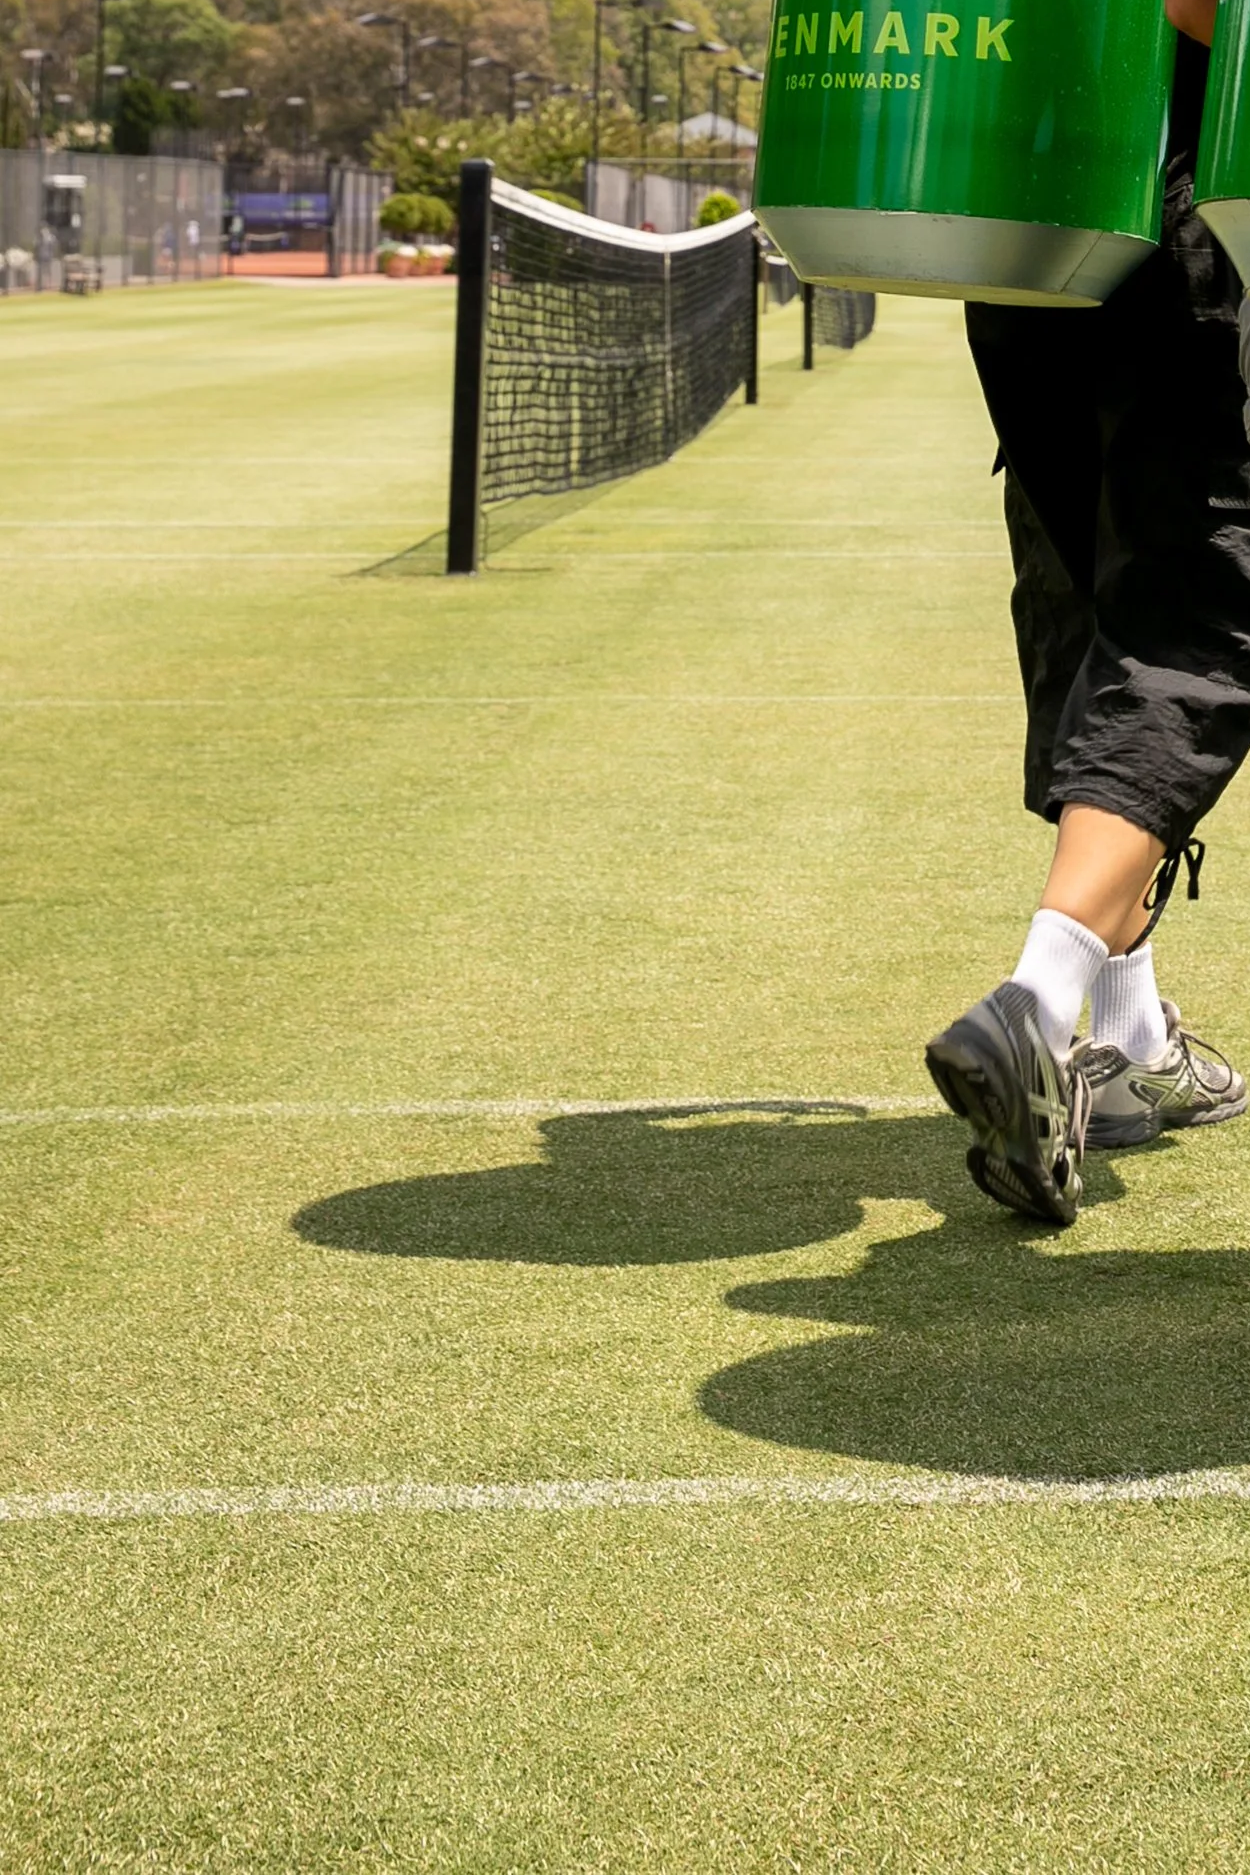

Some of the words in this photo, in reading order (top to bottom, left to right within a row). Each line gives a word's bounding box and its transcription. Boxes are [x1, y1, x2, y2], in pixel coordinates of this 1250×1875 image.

[770, 11, 1015, 62] ENMARK
[785, 73, 814, 91] 1847
[820, 72, 921, 90] ONWARDS
